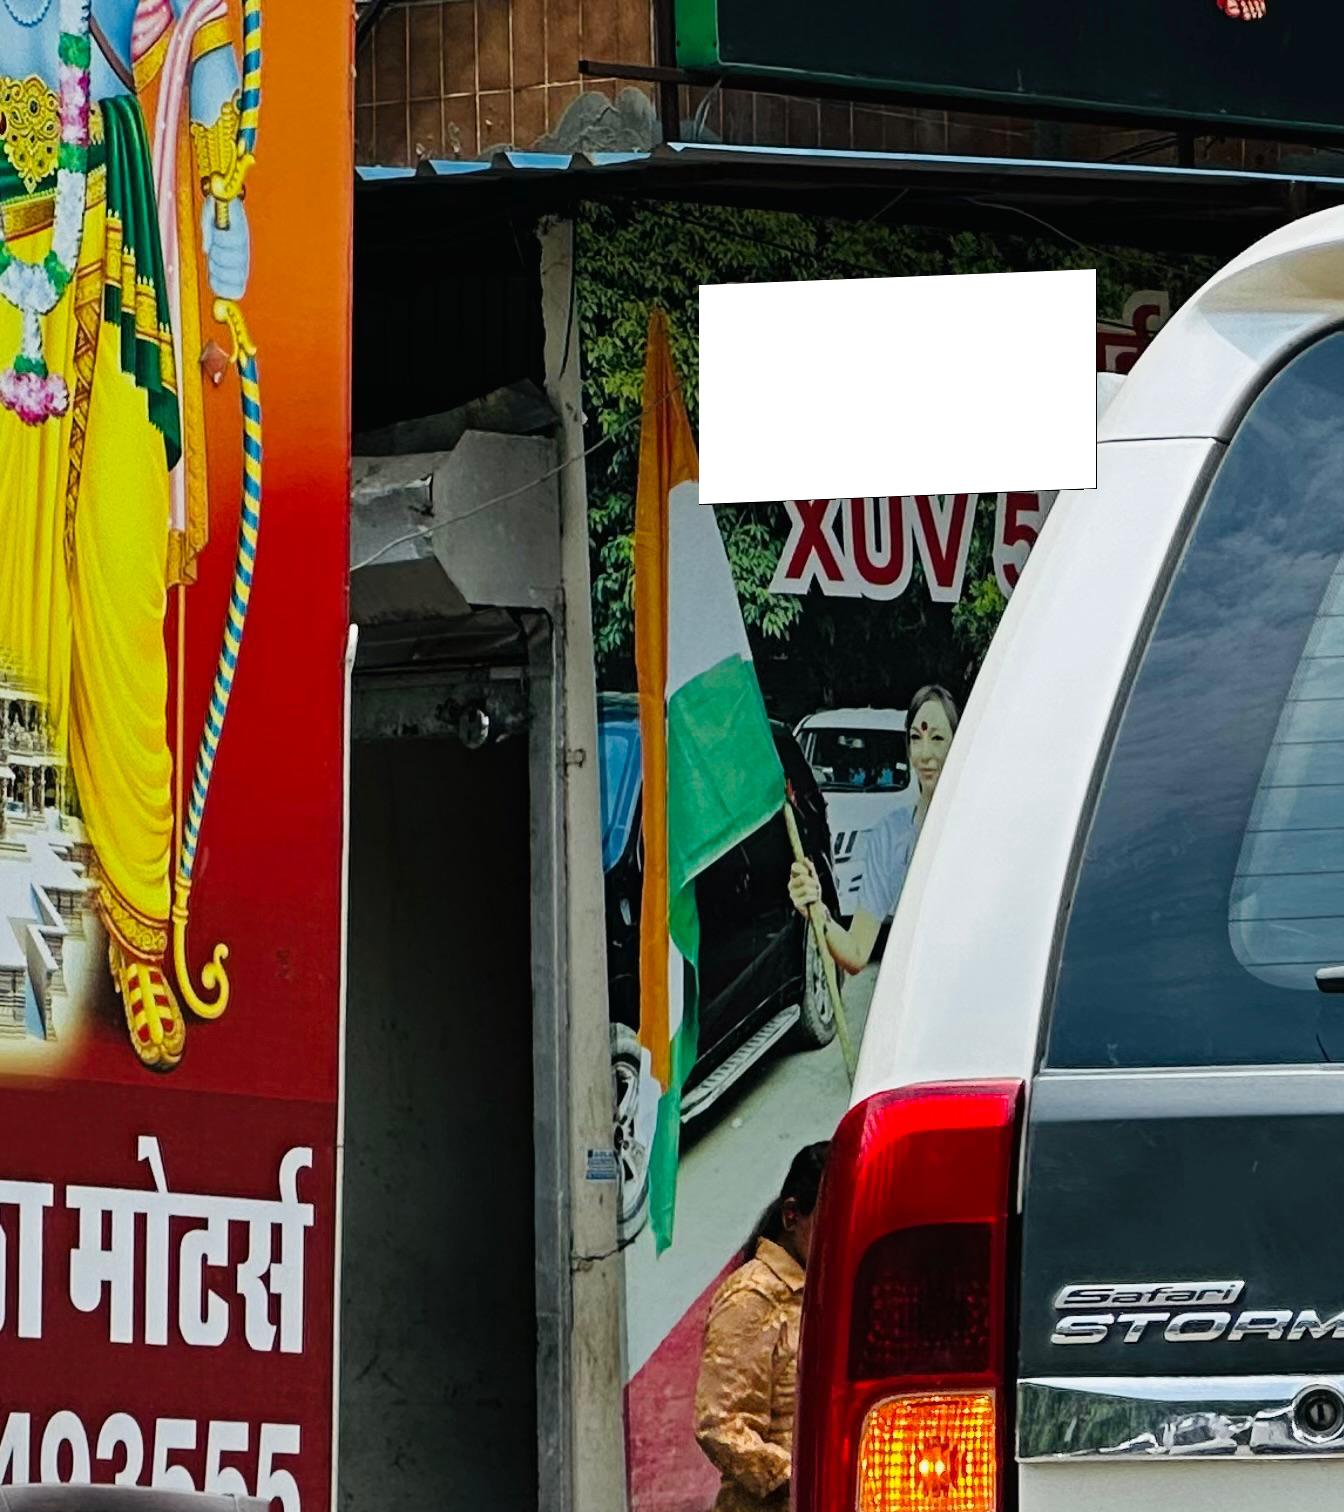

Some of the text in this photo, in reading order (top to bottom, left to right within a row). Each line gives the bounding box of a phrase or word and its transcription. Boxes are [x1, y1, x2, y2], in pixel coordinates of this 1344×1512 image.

[774, 493, 976, 598] XUV
[66, 1135, 314, 1355] मोटर्स
[1060, 1281, 1243, 1308] Safari
